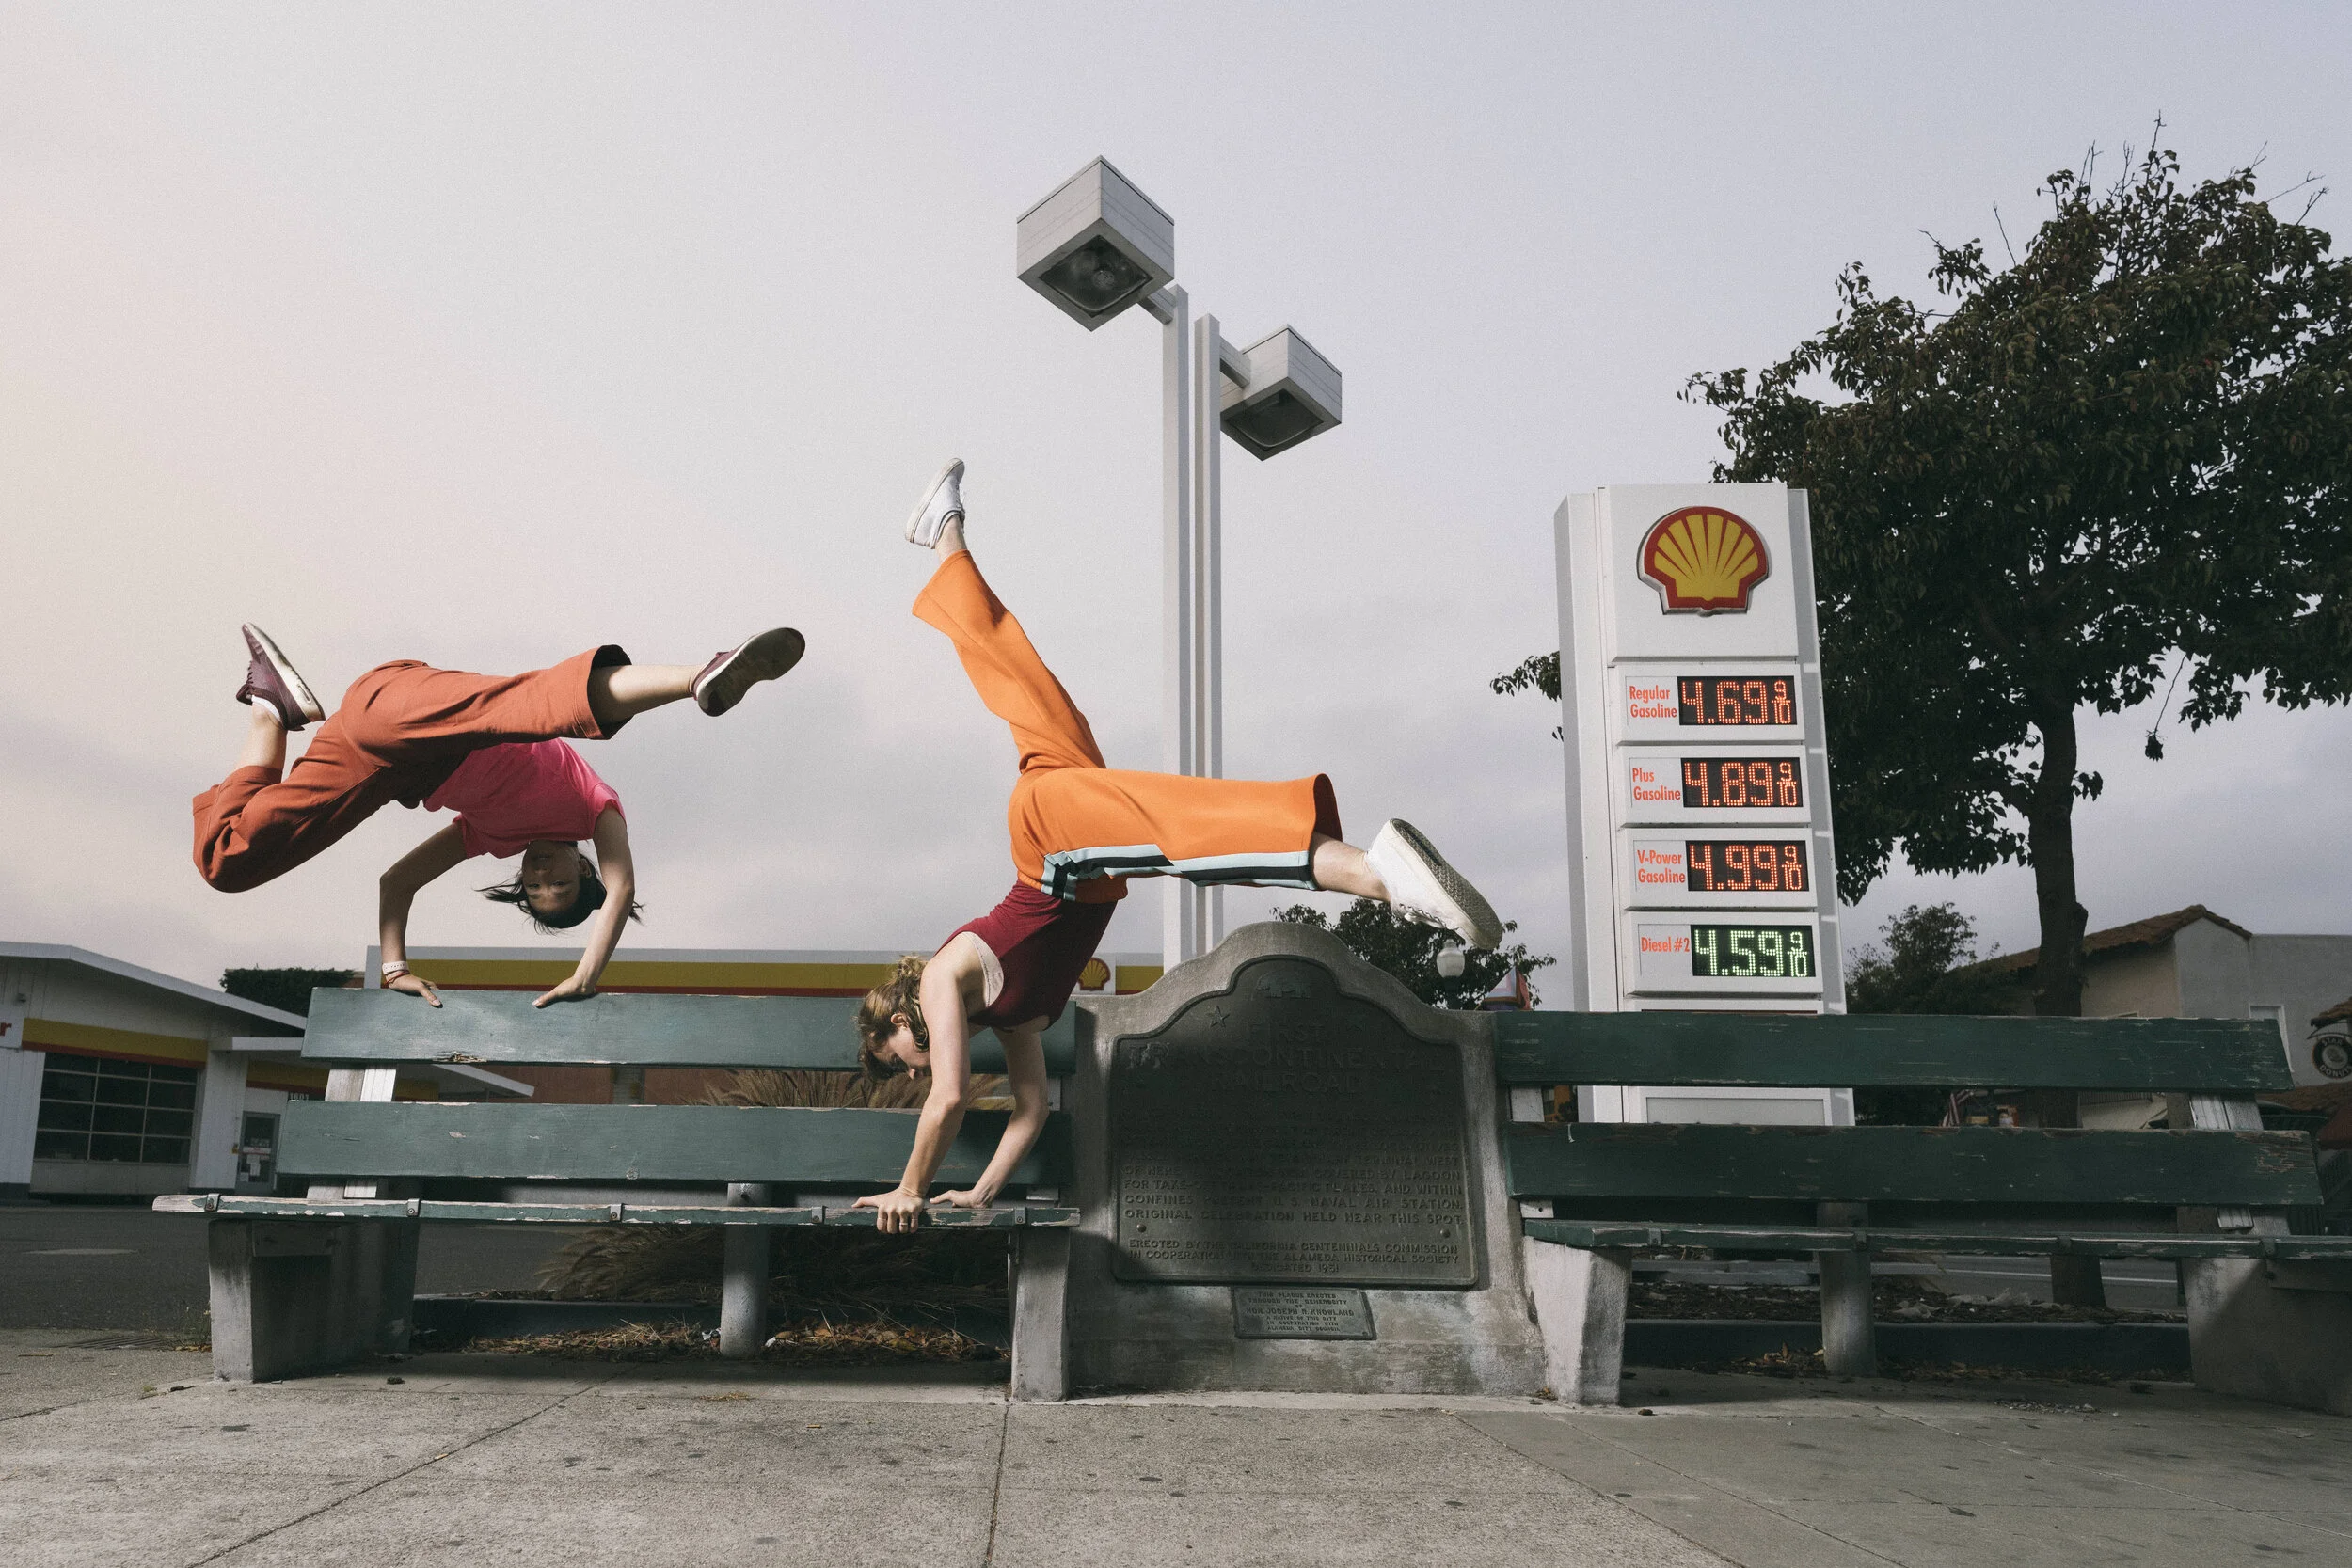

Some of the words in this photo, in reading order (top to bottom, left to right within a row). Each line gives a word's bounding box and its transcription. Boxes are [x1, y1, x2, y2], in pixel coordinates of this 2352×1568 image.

[1629, 685, 1670, 703] Regular
[1682, 681, 1768, 724] 4.69
[1630, 704, 1677, 718] Gasoline
[1632, 768, 1655, 782] Plus
[1633, 785, 1681, 800] Gasoline
[1684, 763, 1773, 806] 4.89
[1637, 849, 1682, 865] V-Power
[1638, 868, 1686, 883] Gasoline
[1690, 845, 1778, 890] 4.99
[1641, 937, 1672, 952] Diesel
[1674, 937, 1691, 952] #2
[1694, 929, 1784, 976] 4.59
[1127, 1041, 1445, 1072] TRNSCONTINENTAL
[1403, 1171, 1460, 1181] LAGOON
[1124, 1180, 1149, 1190] FOR
[1384, 1184, 1412, 1195] AND
[1416, 1184, 1463, 1196] WITHIN
[1124, 1194, 1194, 1206] CONFINES
[1310, 1196, 1357, 1209] NAVAL
[1364, 1197, 1390, 1209] AIR
[1124, 1209, 1193, 1220] ORIGINAL
[1200, 1210, 1295, 1222] CELEBRATION
[1303, 1211, 1337, 1223] HELD
[1344, 1212, 1383, 1224] NEAR
[1389, 1212, 1420, 1225] THIS
[1129, 1239, 1181, 1250] ERECTED
[1185, 1240, 1201, 1251] BY
[1202, 1241, 1226, 1251] THE
[1229, 1241, 1297, 1252] CALIFORNIA
[1384, 1243, 1458, 1255] COMMISSION
[1145, 1250, 1225, 1261] COOPERATION
[1283, 1252, 1340, 1263] ALAMEDA
[1343, 1253, 1408, 1264] HISTORICAL
[1411, 1254, 1459, 1265] SOCIETY
[1251, 1262, 1313, 1274] DEDICATED
